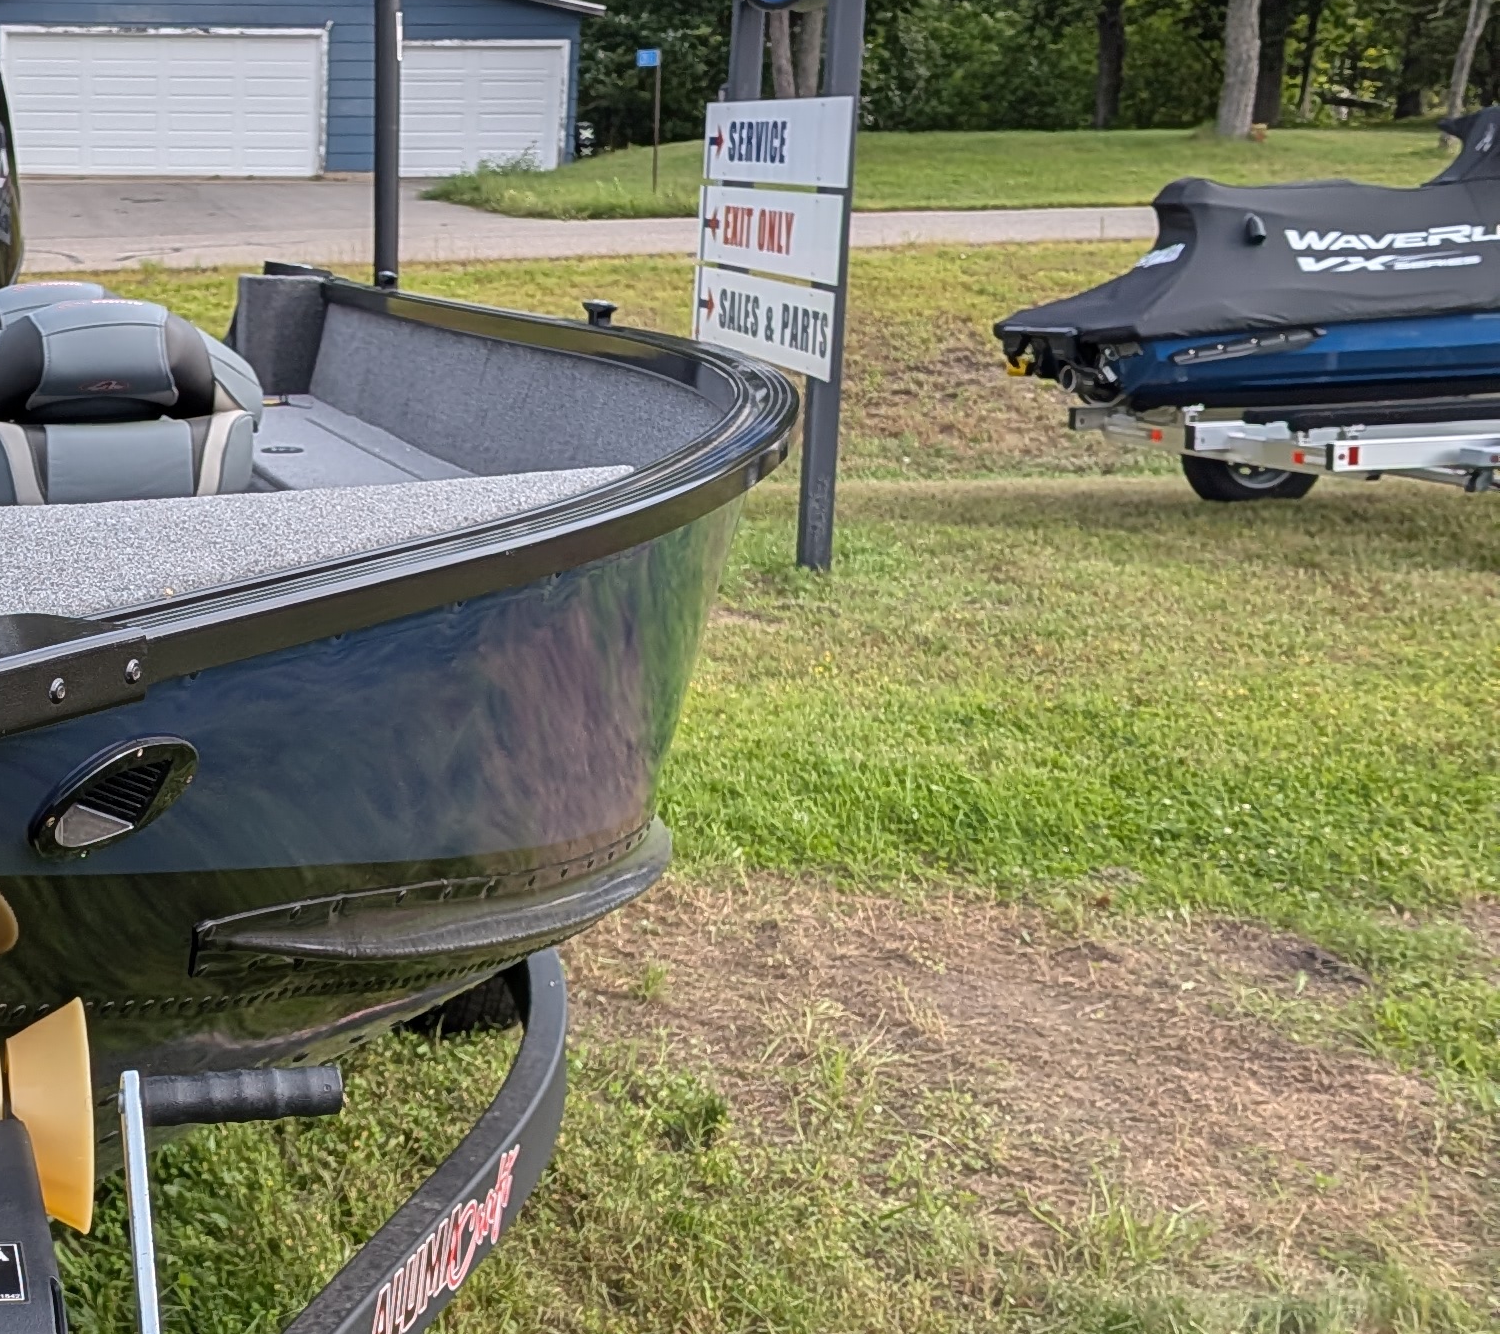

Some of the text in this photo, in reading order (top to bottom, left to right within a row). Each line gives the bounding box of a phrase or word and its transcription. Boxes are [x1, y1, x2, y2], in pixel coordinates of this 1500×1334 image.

[728, 120, 788, 164] SERVICE
[722, 205, 795, 256] EXIT ONLY
[1296, 256, 1395, 272] VX
[718, 288, 829, 359] SALES & PARTS
